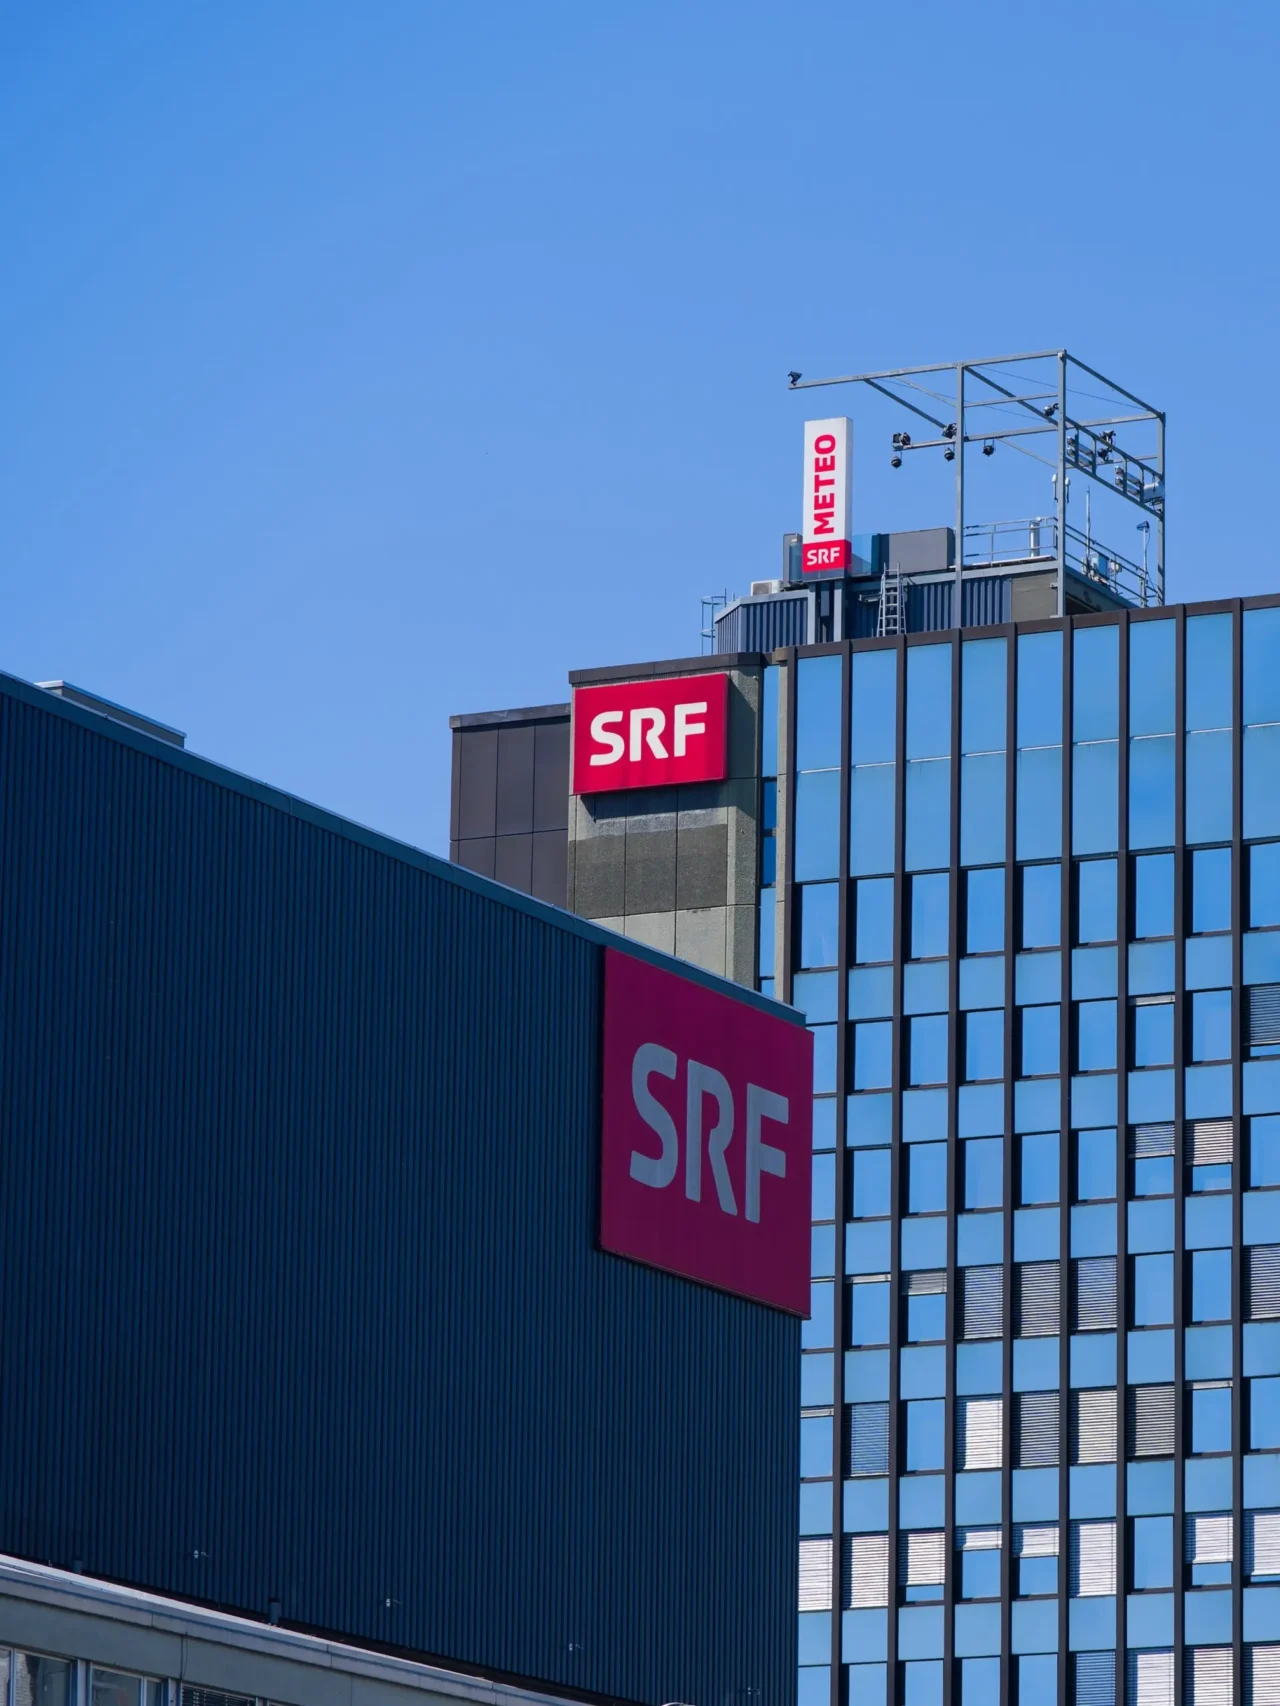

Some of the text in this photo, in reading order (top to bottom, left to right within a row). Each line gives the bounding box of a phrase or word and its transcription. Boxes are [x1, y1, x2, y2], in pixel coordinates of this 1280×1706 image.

[813, 434, 836, 535] METEO
[806, 547, 841, 566] SRF
[589, 701, 708, 766] SRF
[629, 1042, 789, 1224] SRF
